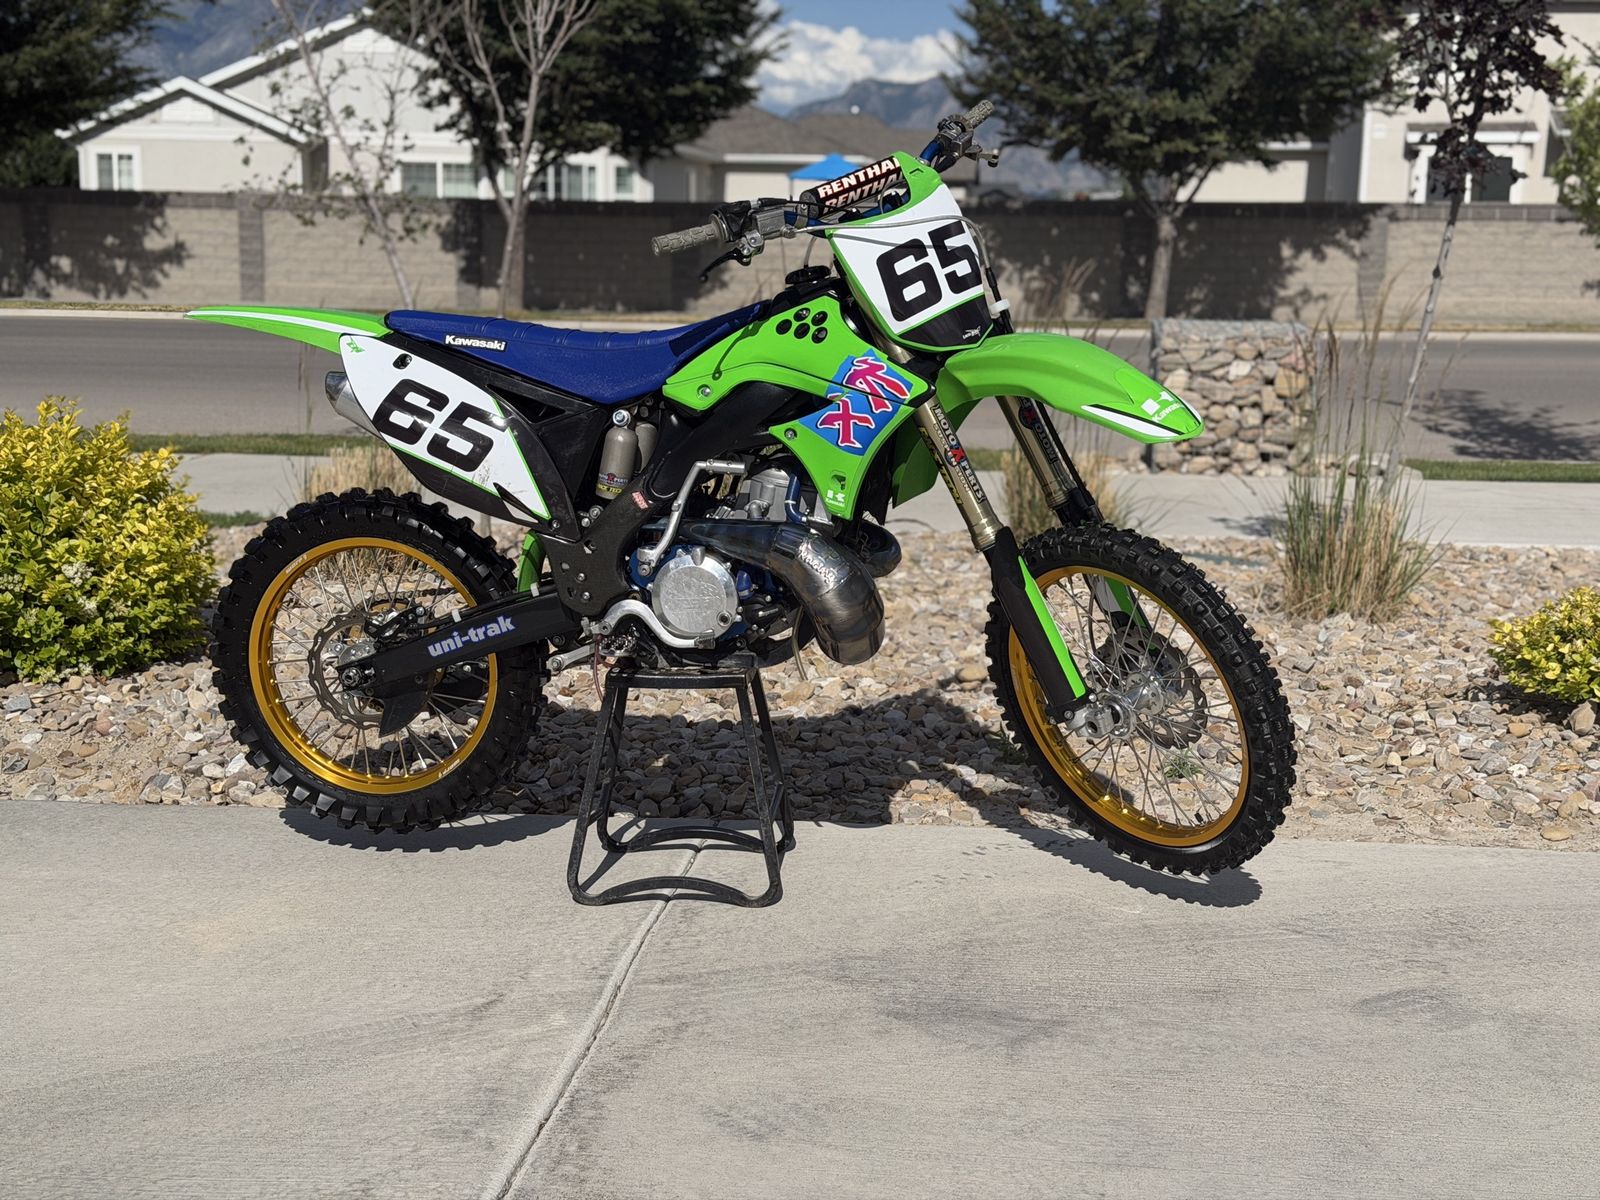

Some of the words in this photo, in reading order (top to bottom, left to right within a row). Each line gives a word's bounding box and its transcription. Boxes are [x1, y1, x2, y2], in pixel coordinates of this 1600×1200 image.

[876, 220, 983, 322] 65
[445, 335, 506, 351] Kawasaki
[372, 378, 509, 472] 65
[428, 616, 515, 657] uni-trak
